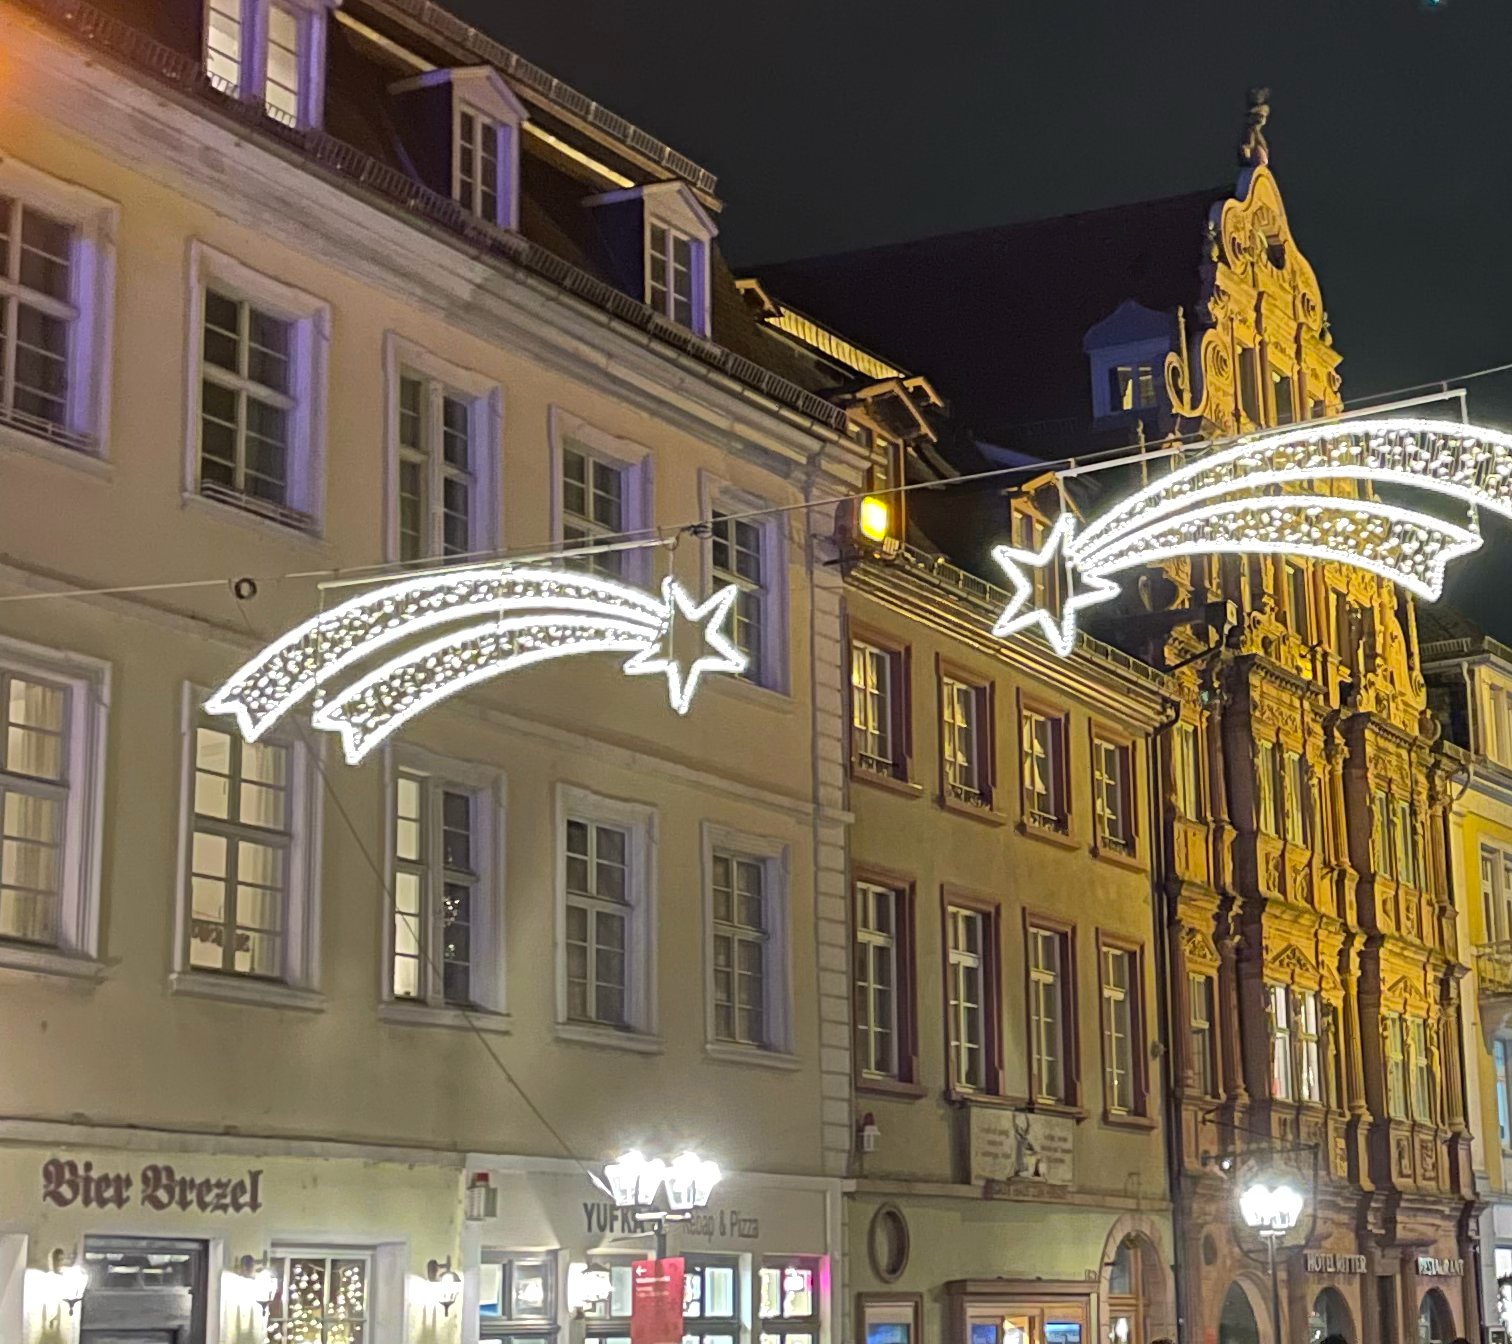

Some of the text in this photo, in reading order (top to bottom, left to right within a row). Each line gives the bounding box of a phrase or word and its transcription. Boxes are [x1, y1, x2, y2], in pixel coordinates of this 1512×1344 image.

[43, 1158, 263, 1214] Bier Brezel
[1307, 1253, 1336, 1273] HOTEL
